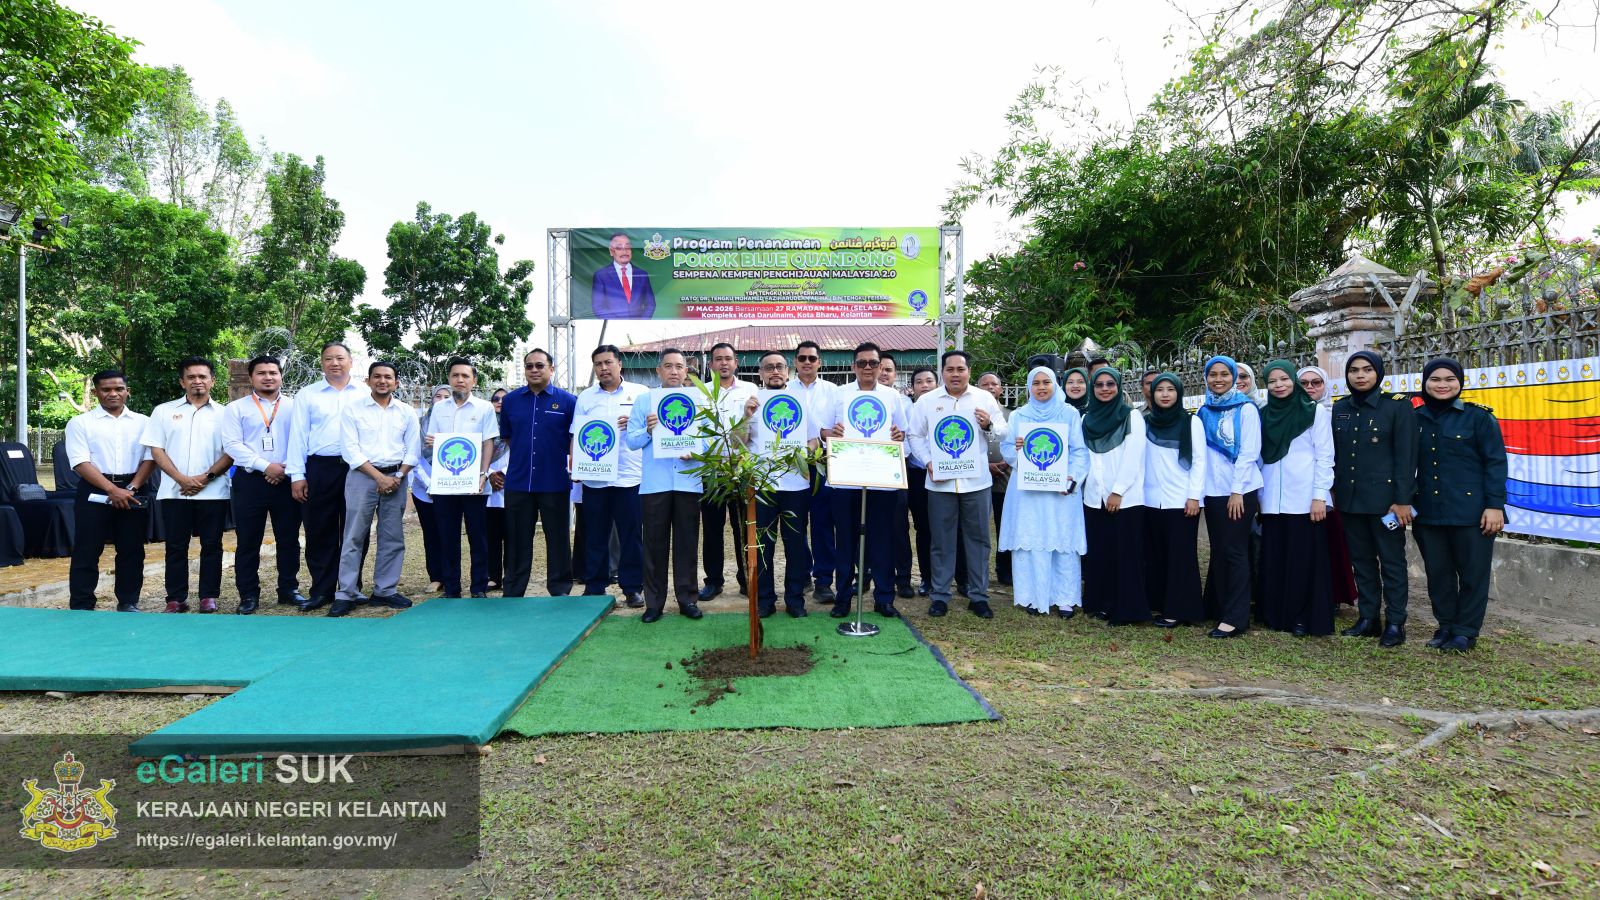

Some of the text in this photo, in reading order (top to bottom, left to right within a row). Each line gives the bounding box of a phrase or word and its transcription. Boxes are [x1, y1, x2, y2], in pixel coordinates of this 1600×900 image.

[673, 237, 821, 252] Program Penanaman
[673, 252, 897, 269] POKOK BLUE QUANDONG
[673, 270, 896, 278] SEMPENA KEMPEN PENGHIJAUAN MALAYSIA 2.0
[938, 463, 974, 471] MALAYSIA
